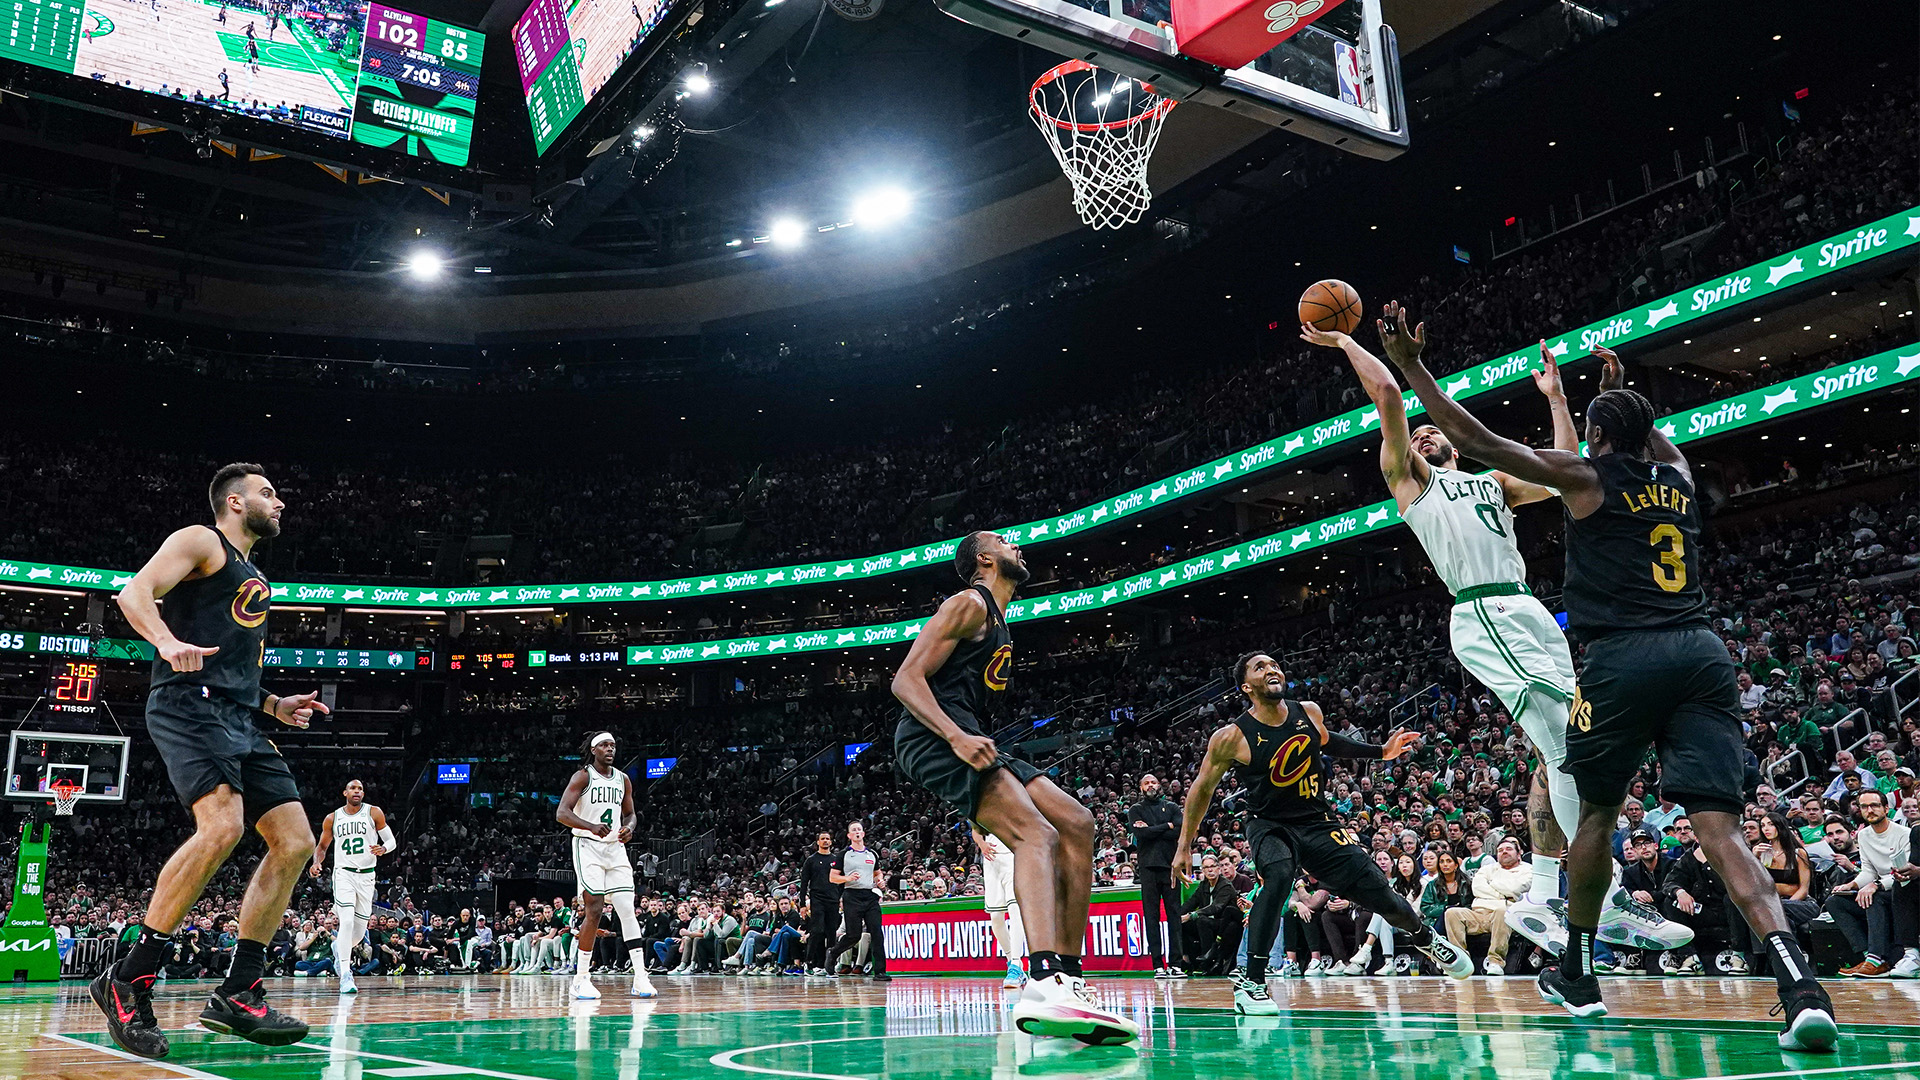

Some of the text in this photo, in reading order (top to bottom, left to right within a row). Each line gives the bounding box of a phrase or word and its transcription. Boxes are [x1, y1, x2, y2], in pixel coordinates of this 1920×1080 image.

[384, 10, 467, 39] CLEVELAND BOSTON
[378, 20, 468, 61] 102 85
[369, 58, 381, 68] 20
[401, 63, 441, 87] 7:05
[455, 80, 470, 91] 4th
[303, 110, 345, 129] FLEXCAR
[372, 99, 457, 134] CELTICS PLAYOFFS
[1818, 229, 1887, 267] Sprite
[1691, 277, 1751, 311] Sprite
[1580, 319, 1632, 351] Sprite
[1481, 356, 1527, 386] Sprite
[1812, 365, 1878, 400] Sprite
[1689, 403, 1747, 435] Sprite
[1312, 419, 1350, 445] Sprite
[1240, 446, 1274, 470] Sprite
[1174, 471, 1205, 493] Sprite
[1114, 493, 1143, 515] Sprite
[1056, 514, 1086, 535] Sprite
[1319, 517, 1356, 542] Sprite
[1474, 503, 1507, 539] 0
[923, 544, 955, 562] Sprite
[1248, 539, 1282, 563] Sprite
[1650, 523, 1687, 593] 3
[792, 566, 827, 582] Sprite
[862, 557, 893, 574] Sprite
[1183, 559, 1214, 581] Sprite
[60, 569, 103, 584] Sprite
[723, 574, 758, 590] Sprite
[296, 585, 335, 602] Sprite
[371, 588, 409, 603] Sprite
[515, 587, 552, 603] Sprite
[586, 584, 622, 600] Sprite
[657, 581, 692, 597] Sprite
[1123, 577, 1153, 598] Sprite
[445, 590, 481, 605] Sprite
[1058, 593, 1094, 612] Sprite
[1005, 605, 1024, 619] rite
[0, 633, 89, 653] 85 BOSTON
[794, 634, 828, 650] Sprite
[863, 627, 897, 644] Sprite
[476, 654, 493, 662] 7:05
[531, 652, 619, 664] TD Bank 9:13 PM
[659, 647, 695, 662] Sprite
[727, 641, 760, 657] Sprite
[66, 663, 97, 678] 7:05
[296, 657, 302, 665] 3
[317, 658, 324, 666] 4
[337, 658, 348, 666] 20
[359, 659, 370, 667] 28
[418, 657, 430, 666] 20
[502, 660, 515, 668] 102
[56, 676, 92, 701] 20
[62, 705, 96, 713] TISSOT
[1269, 733, 1312, 788] C
[1299, 773, 1319, 799] 45
[591, 786, 623, 806] CELTICS
[600, 808, 613, 829] 4
[337, 821, 367, 838] CELTICS
[341, 837, 364, 855] 42
[27, 863, 40, 873] GET
[26, 873, 39, 883] THE
[28, 884, 41, 896] App
[882, 922, 936, 959] NONSTOP
[938, 920, 993, 958] PLAYOFF
[1089, 914, 1124, 956] THE
